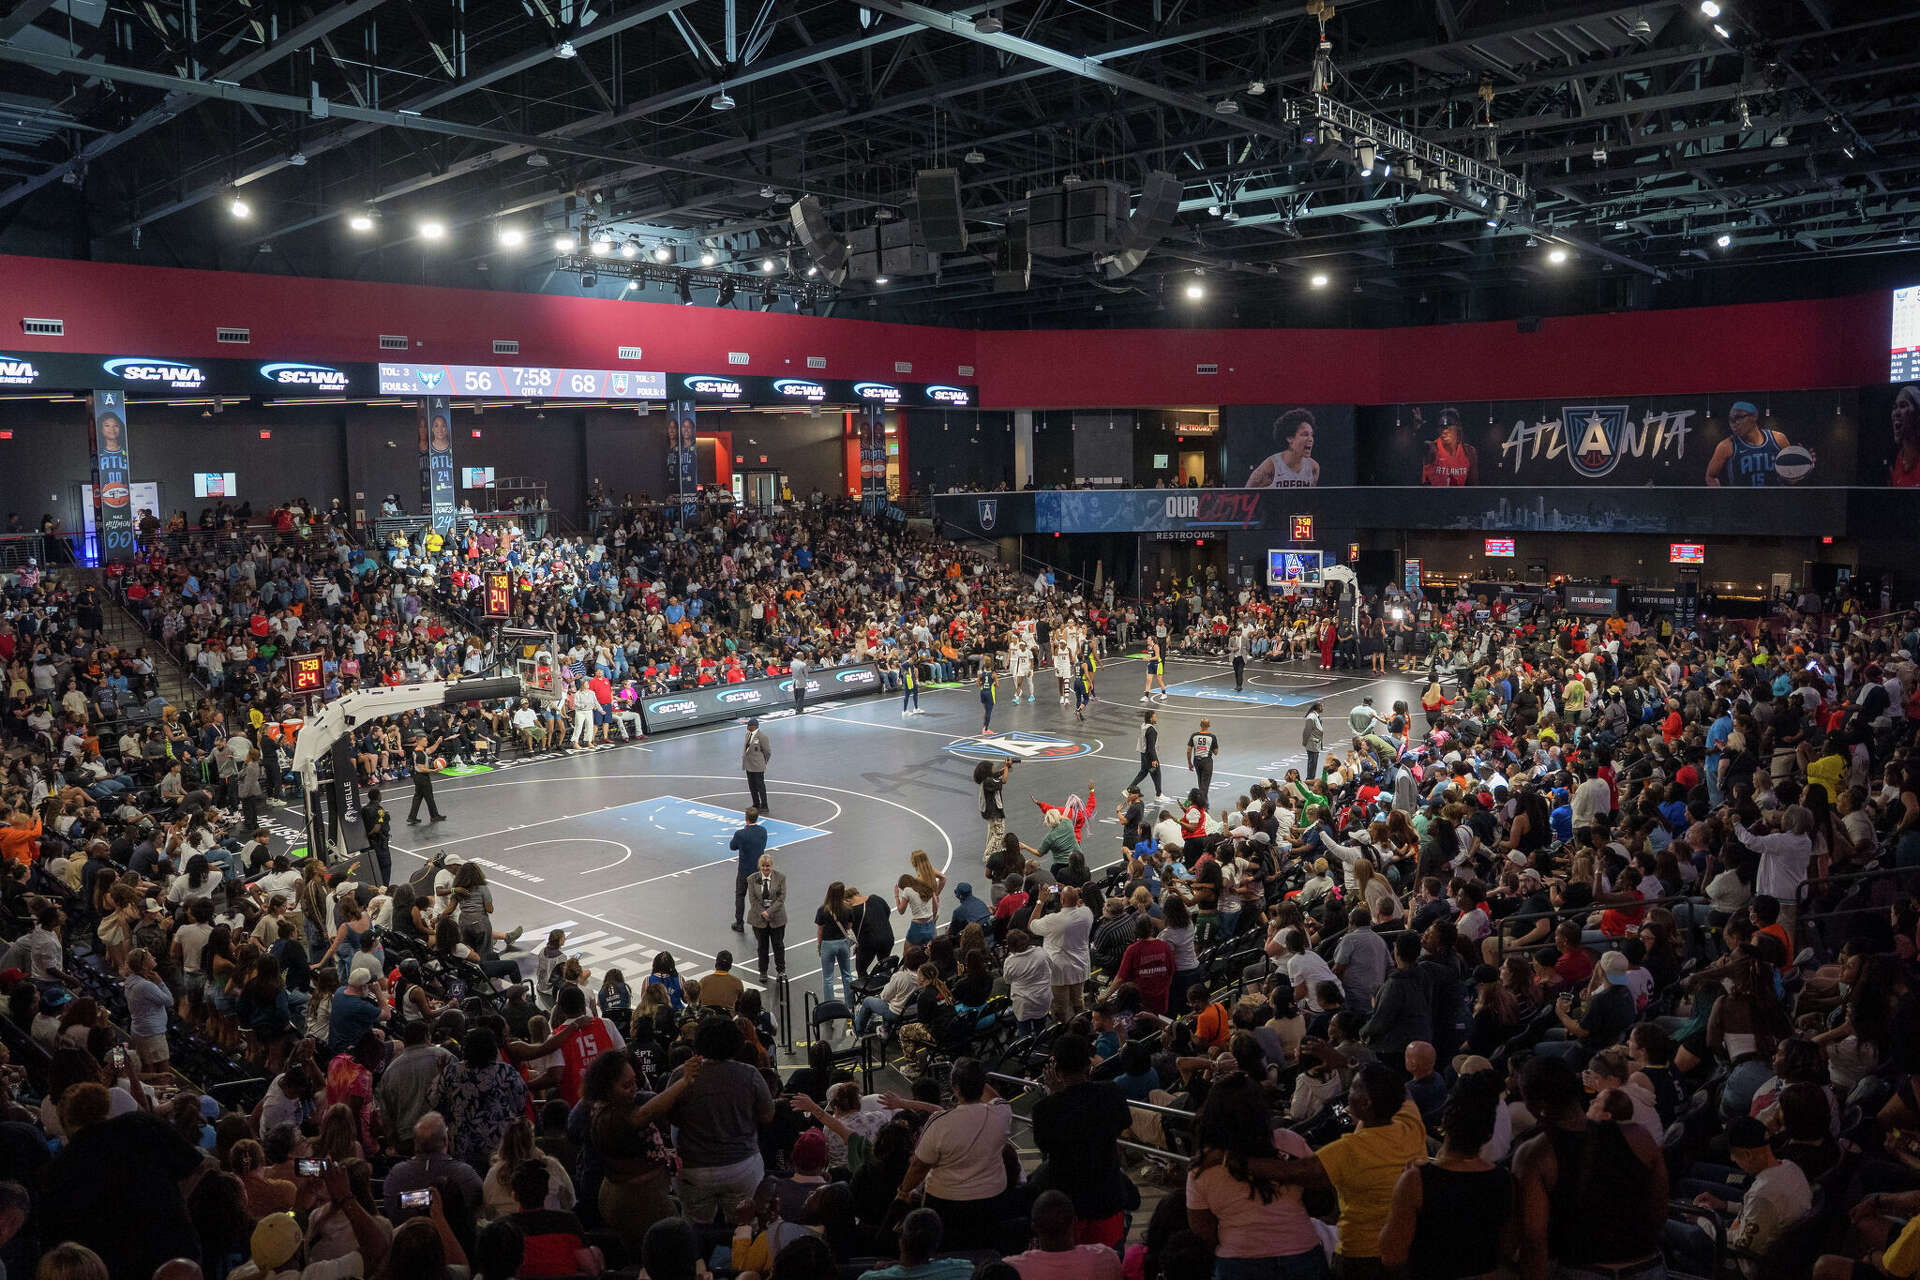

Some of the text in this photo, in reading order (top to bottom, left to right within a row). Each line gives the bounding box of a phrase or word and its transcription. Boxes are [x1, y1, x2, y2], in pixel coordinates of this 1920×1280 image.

[465, 371, 492, 391] 56
[512, 368, 551, 386] 7:58
[571, 374, 596, 393] 68
[1501, 407, 1697, 475] ATLANTA
[1166, 492, 1260, 530] OUR CITY
[1156, 532, 1216, 540] RESTROOMS
[1295, 526, 1310, 538] 24
[492, 575, 508, 588] 7:58
[491, 591, 508, 612] 24
[298, 659, 318, 671] 7:58
[298, 673, 316, 687] 24
[576, 1034, 598, 1057] 15
